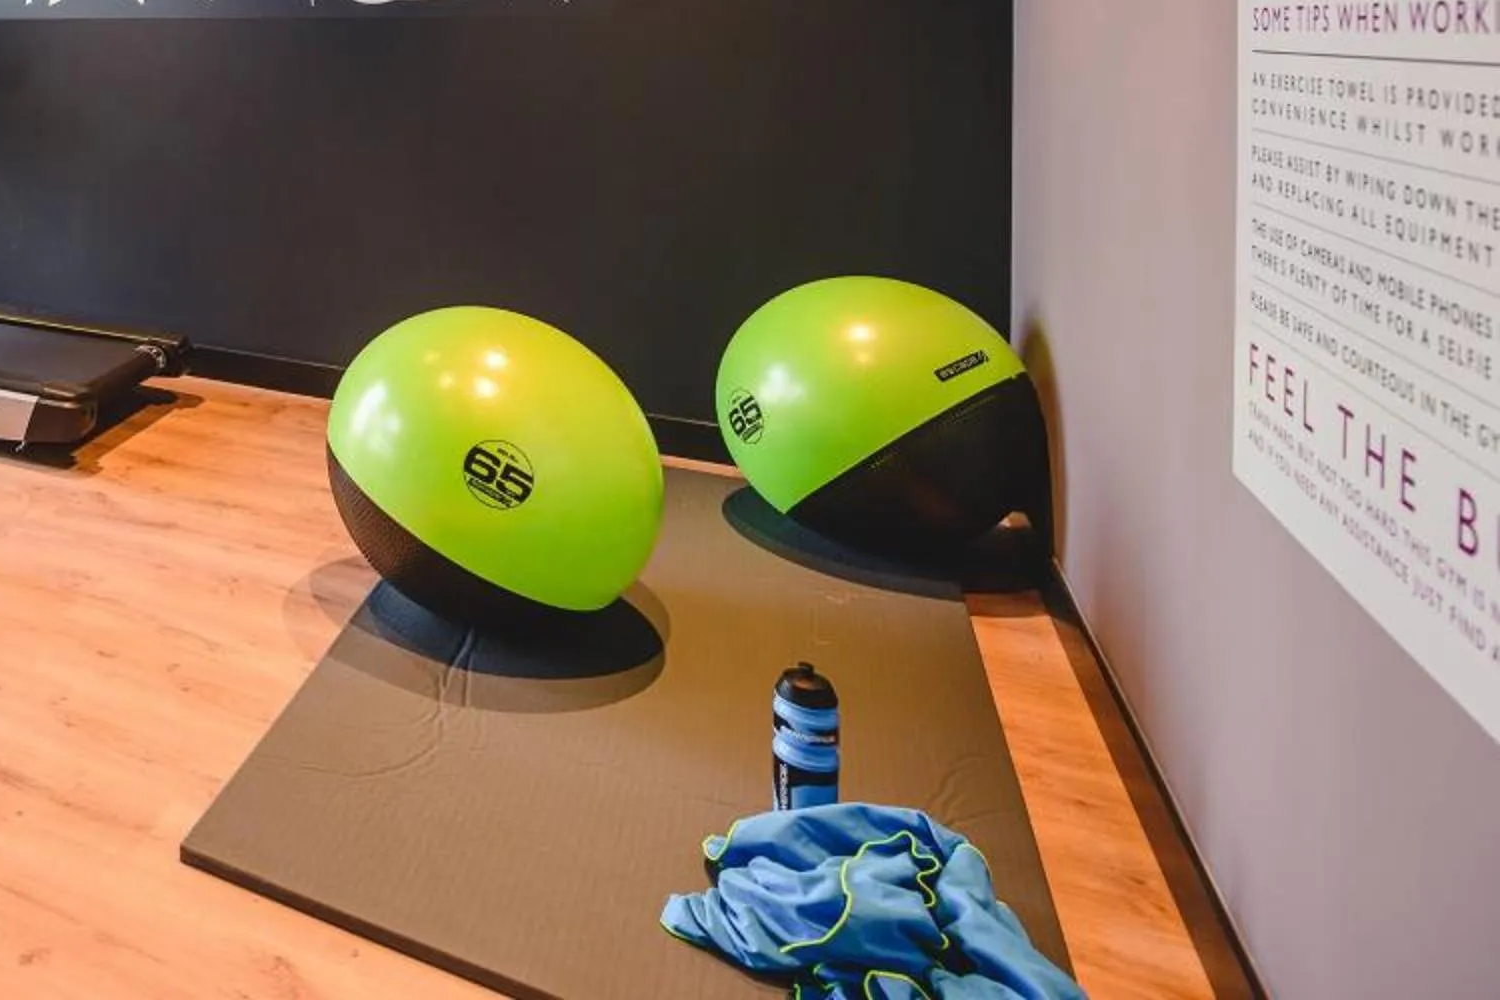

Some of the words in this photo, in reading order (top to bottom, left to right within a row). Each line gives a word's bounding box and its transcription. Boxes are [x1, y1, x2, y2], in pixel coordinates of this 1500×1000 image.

[1253, 6, 1289, 31] SOME
[1296, 4, 1328, 32] TIPS
[1338, 2, 1397, 32] WHEN
[1403, 184, 1456, 217] DOWN
[1430, 293, 1492, 339] PHONES
[1438, 335, 1492, 380] SELFIE
[728, 395, 762, 437] 65
[1249, 343, 1314, 433] FEEL
[1337, 404, 1416, 513] THE
[1420, 391, 1436, 415] IN
[1440, 401, 1469, 438] THE
[463, 445, 534, 505] 65
